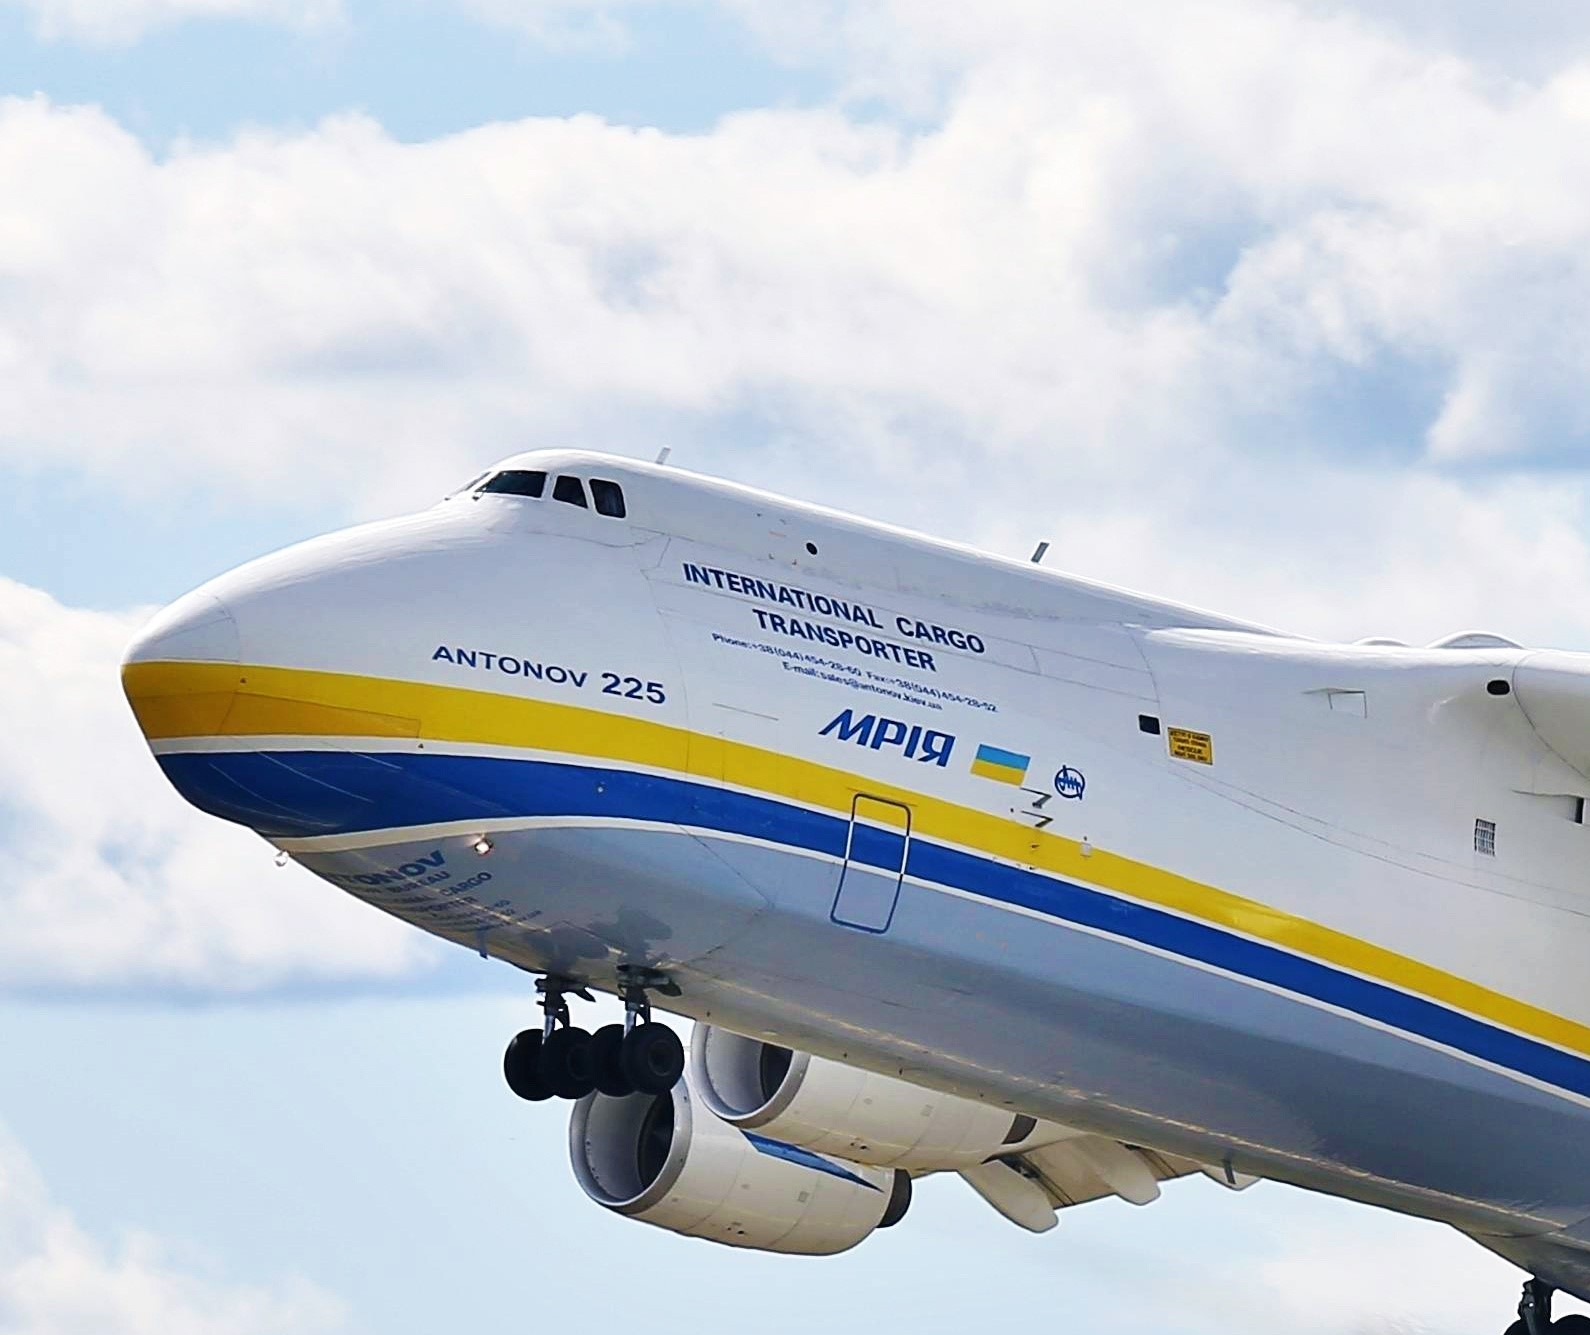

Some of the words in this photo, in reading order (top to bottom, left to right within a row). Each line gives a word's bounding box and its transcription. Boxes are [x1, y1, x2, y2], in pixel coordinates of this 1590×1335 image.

[683, 562, 884, 630] INTERNATIONAL
[895, 616, 986, 654] CARGO
[752, 608, 938, 672] TRANSPORTER
[431, 645, 589, 688] ANTONOV
[601, 671, 667, 705] 225
[818, 708, 956, 768] МРІЯ
[439, 870, 492, 897] CARGO
